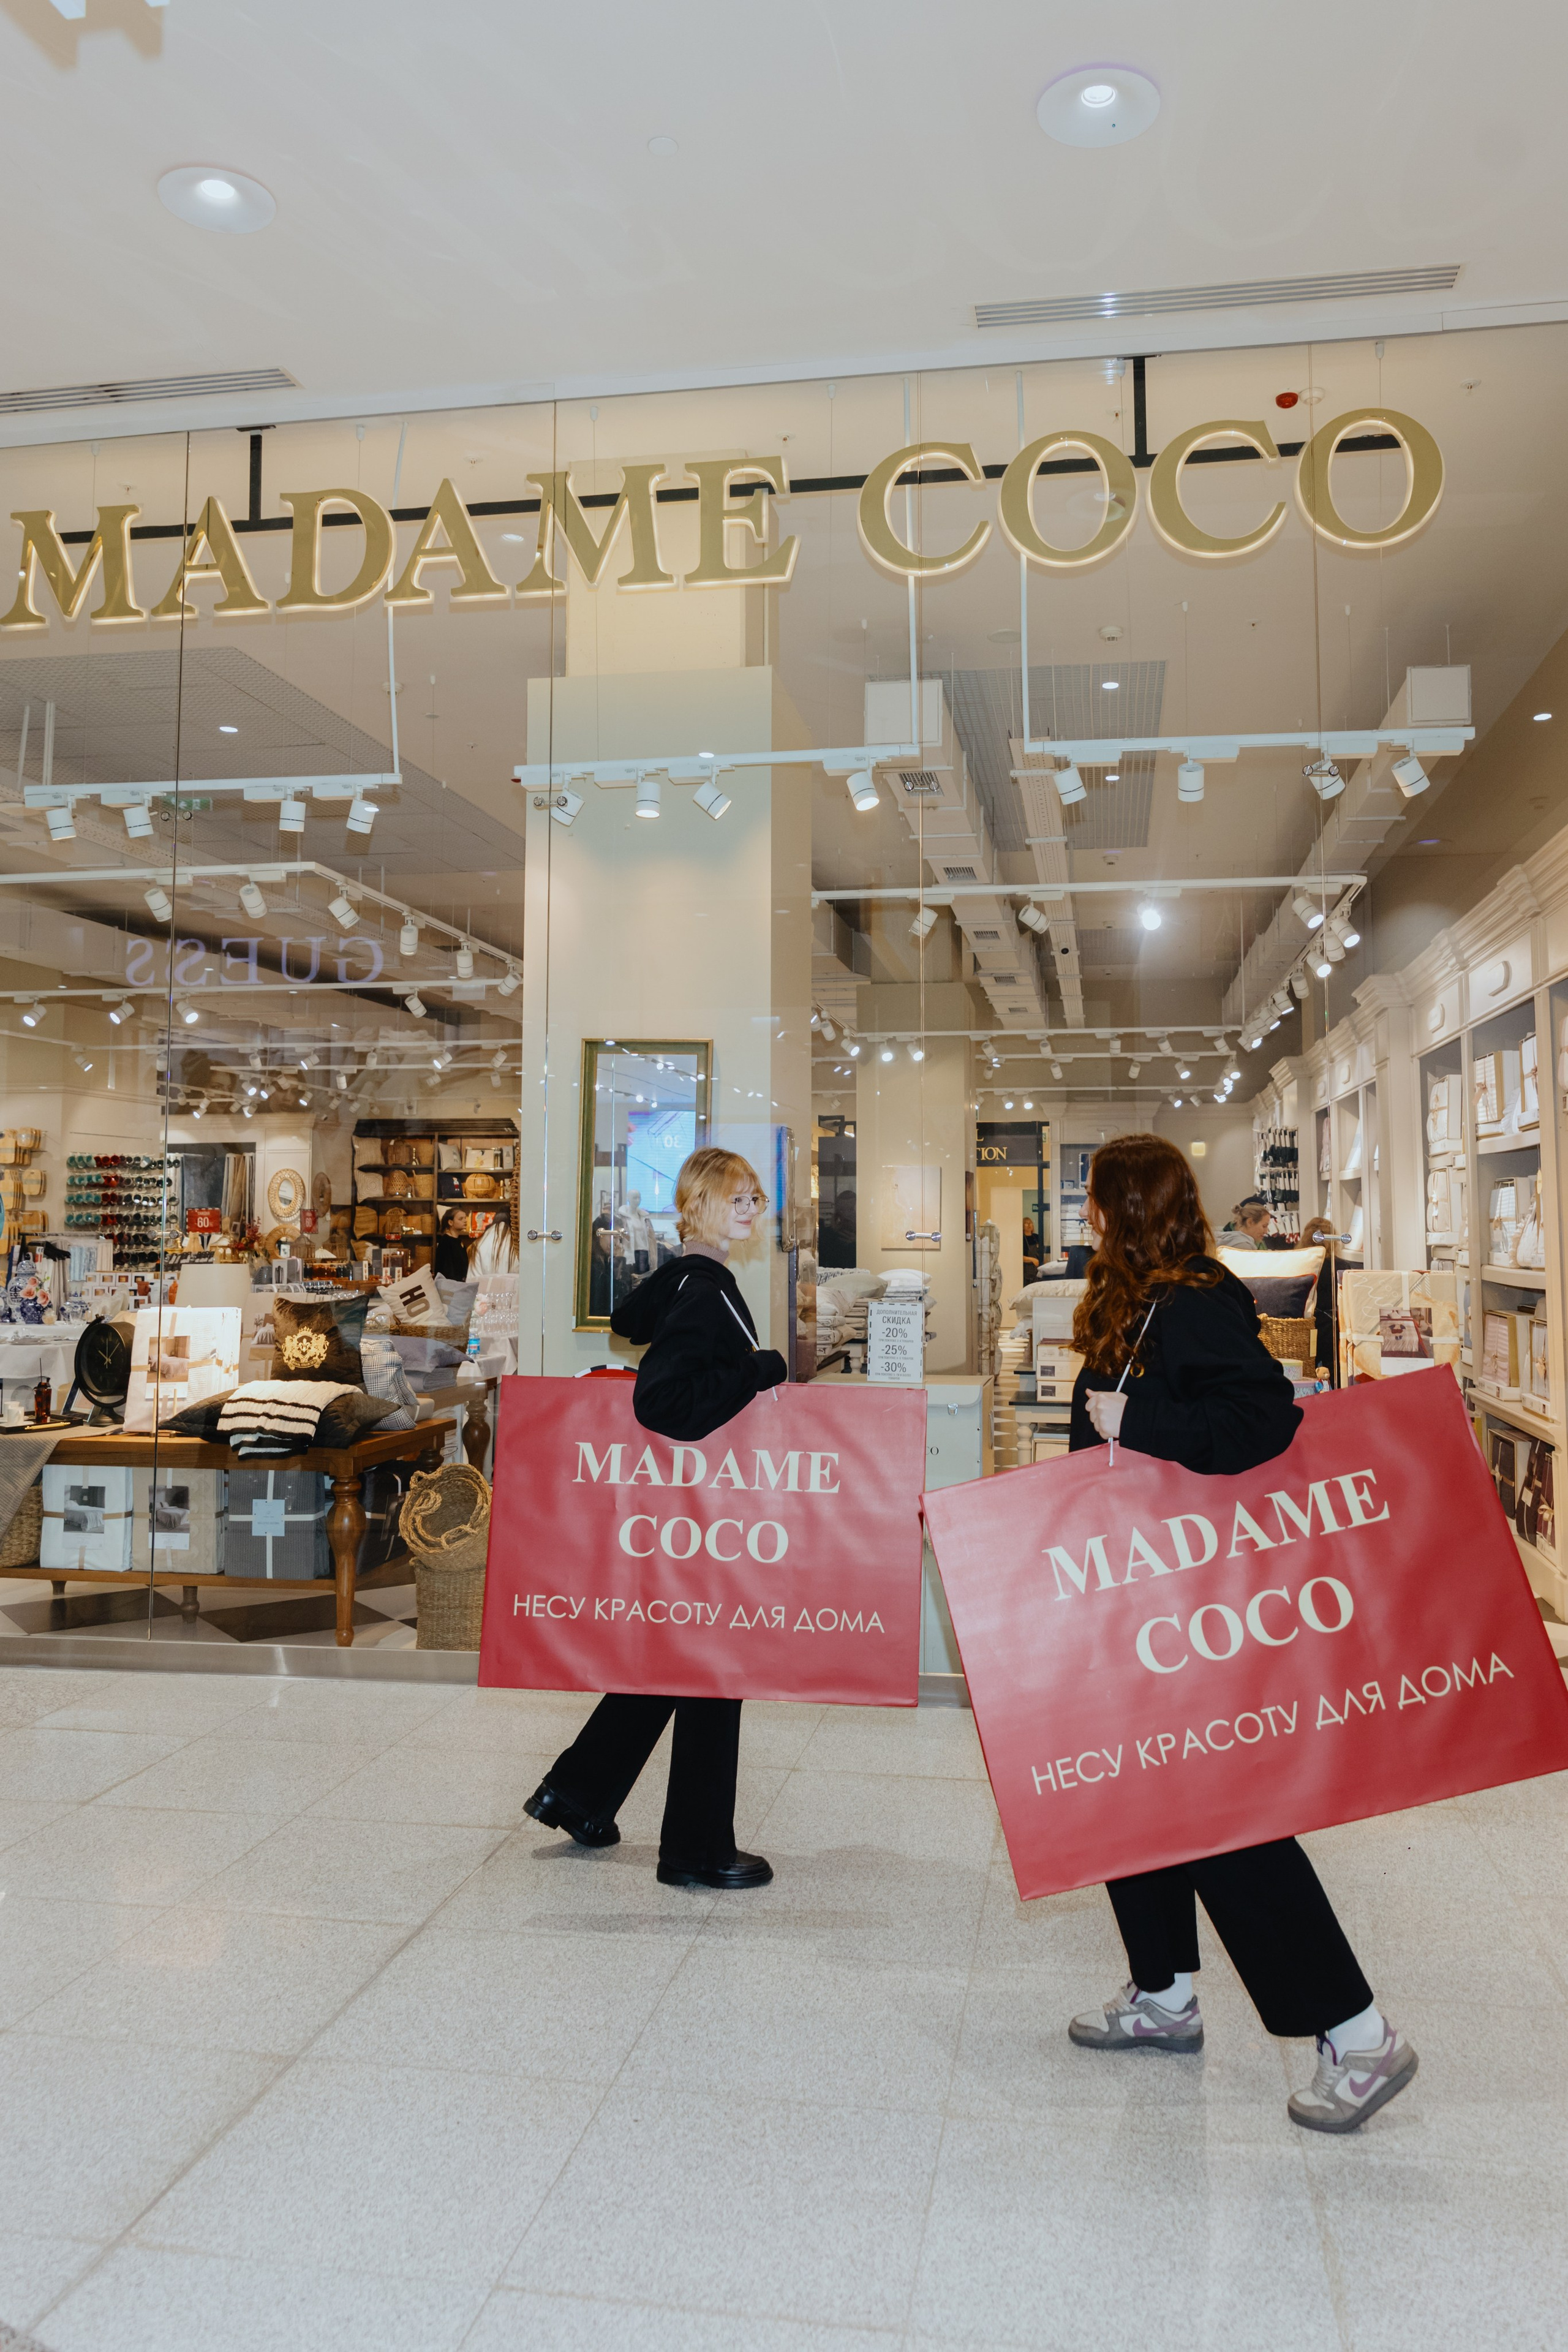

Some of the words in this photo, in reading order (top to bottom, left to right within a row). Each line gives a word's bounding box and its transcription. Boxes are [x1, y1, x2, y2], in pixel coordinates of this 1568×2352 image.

[1, 455, 800, 631] MADAME
[858, 407, 1446, 577] COCO
[882, 1316, 911, 1325] СКИДКА
[882, 1327, 908, 1338] -20%
[881, 1344, 907, 1355] -25%
[881, 1362, 907, 1373] -30%
[572, 1442, 840, 1494] MADAME
[619, 1515, 789, 1564] COCO
[1042, 1469, 1390, 1601] MADAME
[513, 1594, 586, 1619] НЕСУ
[595, 1597, 722, 1626] КРАСОТУ
[729, 1604, 786, 1630] ДЛЯ
[793, 1607, 886, 1634] ДОМА
[1135, 1577, 1354, 1674] COCO
[1031, 1744, 1123, 1795] НЕСУ
[1136, 1701, 1298, 1769] КРАСОТУ
[1316, 1681, 1385, 1730] ДЛЯ
[1398, 1652, 1514, 1709] ДОМА
